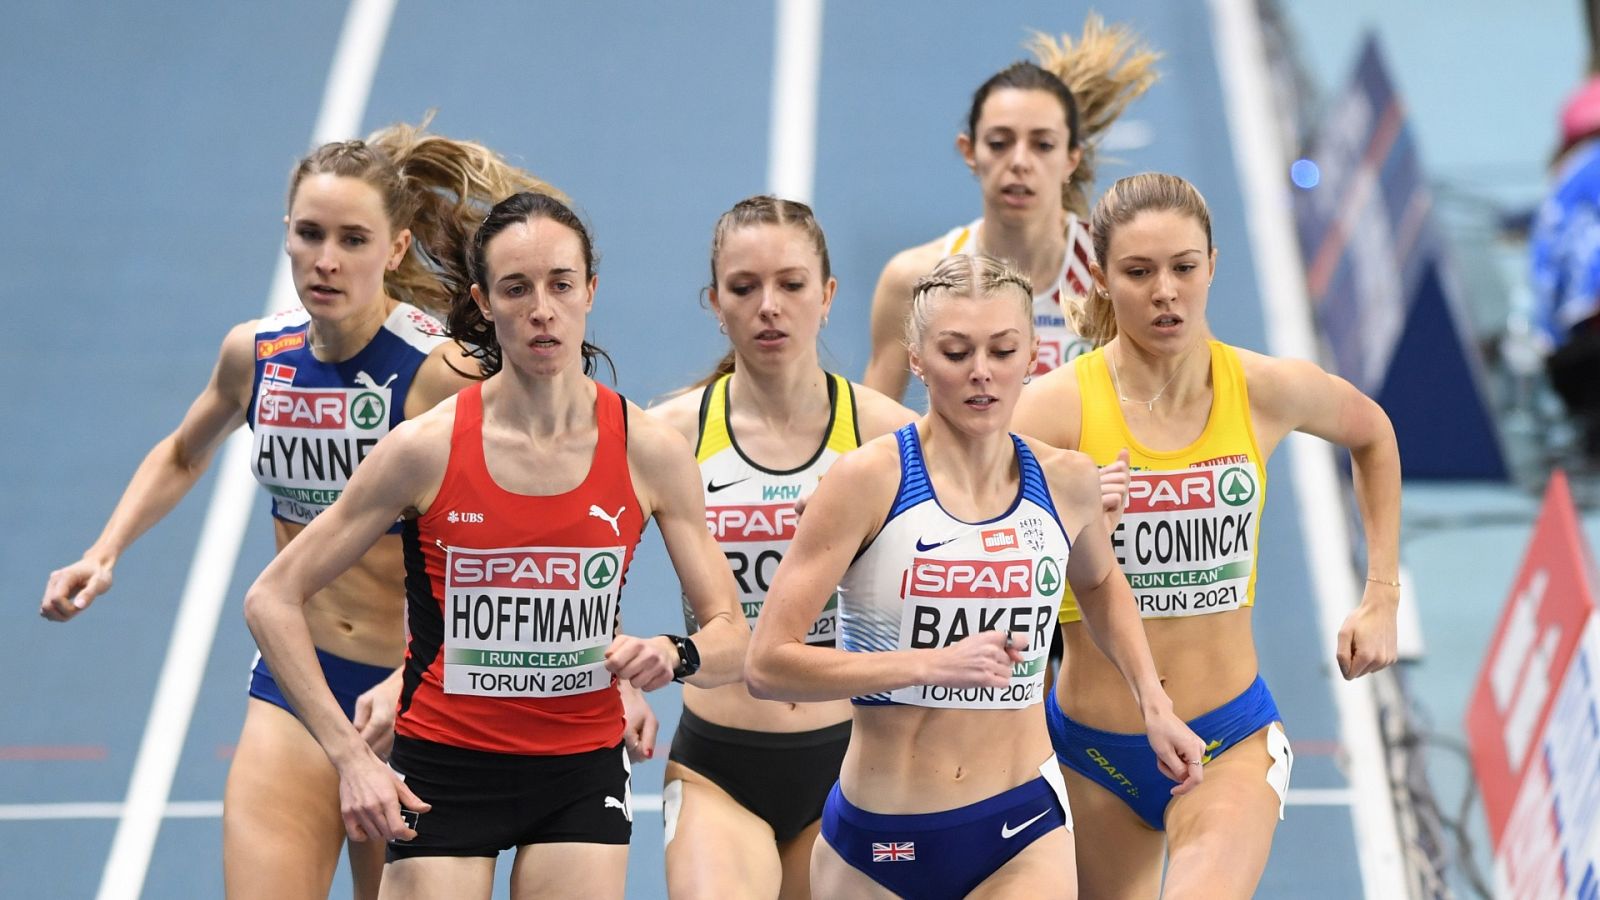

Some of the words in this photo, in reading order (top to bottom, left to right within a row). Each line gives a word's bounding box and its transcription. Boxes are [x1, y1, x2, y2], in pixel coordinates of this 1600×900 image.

[259, 394, 344, 424] SPAR
[312, 490, 343, 504] CLE
[1124, 477, 1212, 508] PAR
[461, 513, 484, 523] UBS
[985, 532, 1014, 547] müller
[1111, 524, 1126, 564] E
[1135, 512, 1252, 565] CONINCK
[454, 556, 577, 585] SPAR
[723, 549, 783, 594] RO
[915, 564, 1029, 593] SPAR
[1131, 574, 1164, 587] RUN
[1135, 590, 1187, 611] RUŃ
[1194, 586, 1238, 609] 2021
[452, 593, 611, 643] HOFFMANN
[910, 605, 1052, 652] BAKER
[480, 652, 486, 664] I
[490, 652, 524, 665] RUN
[468, 672, 545, 692] TORUŃ
[552, 670, 593, 692] 2021
[1086, 748, 1132, 786] CRAFT
